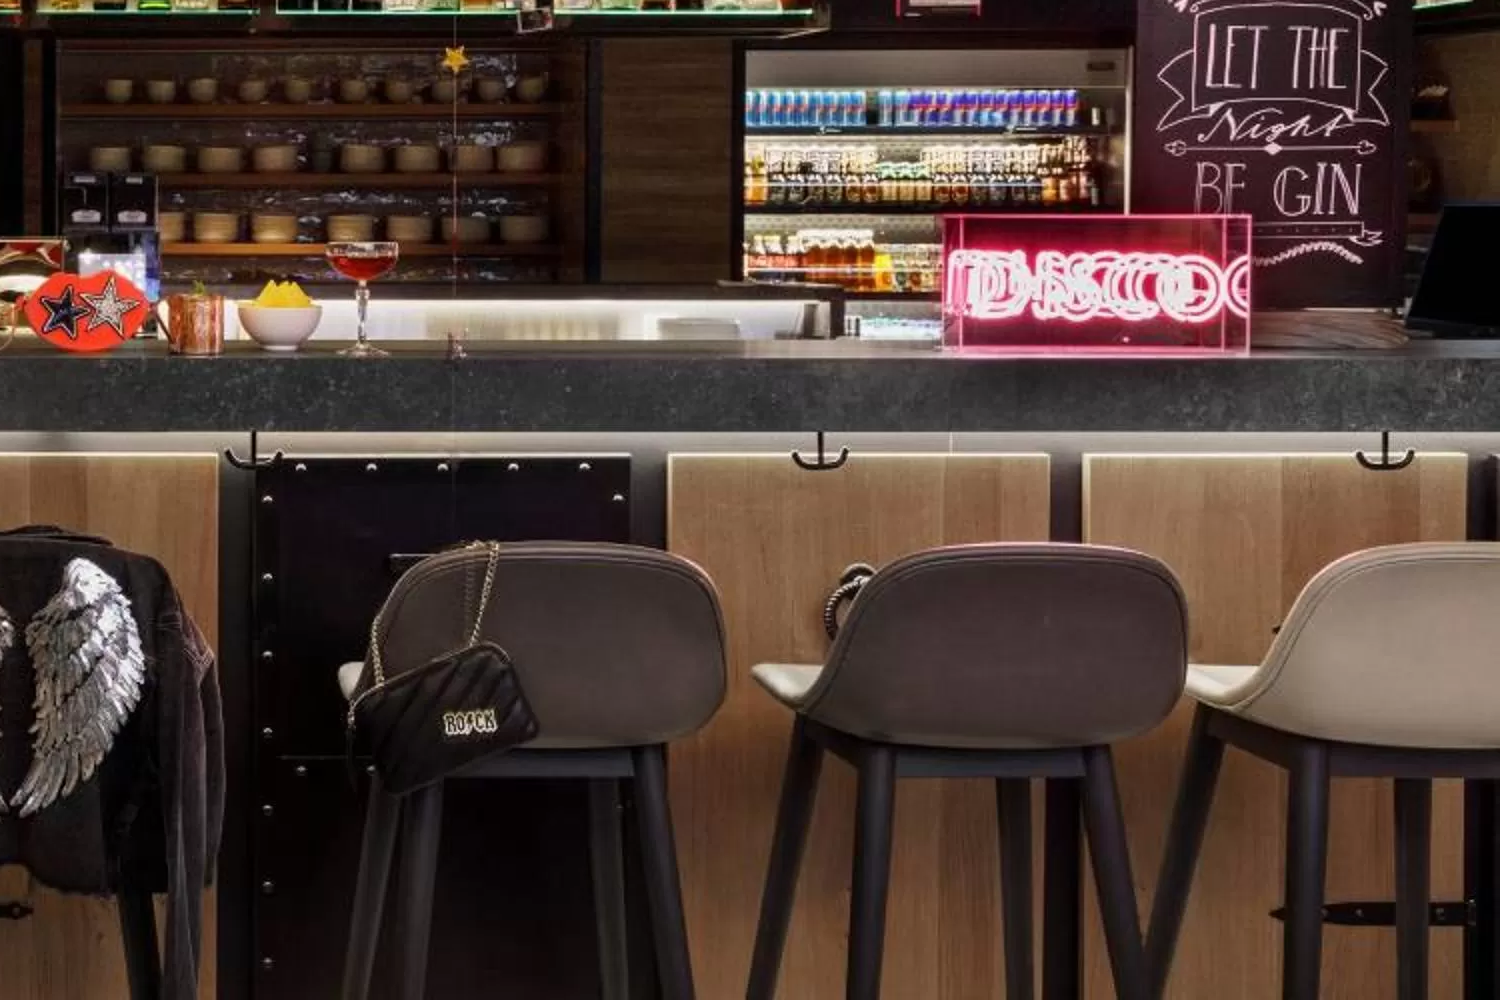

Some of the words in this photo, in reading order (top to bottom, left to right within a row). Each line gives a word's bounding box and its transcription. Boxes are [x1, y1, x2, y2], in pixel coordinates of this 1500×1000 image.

[1204, 23, 1269, 89] LET
[1288, 25, 1349, 90] THE
[1197, 107, 1356, 143] Night
[1195, 161, 1248, 216] BE
[1273, 162, 1363, 217] GIN
